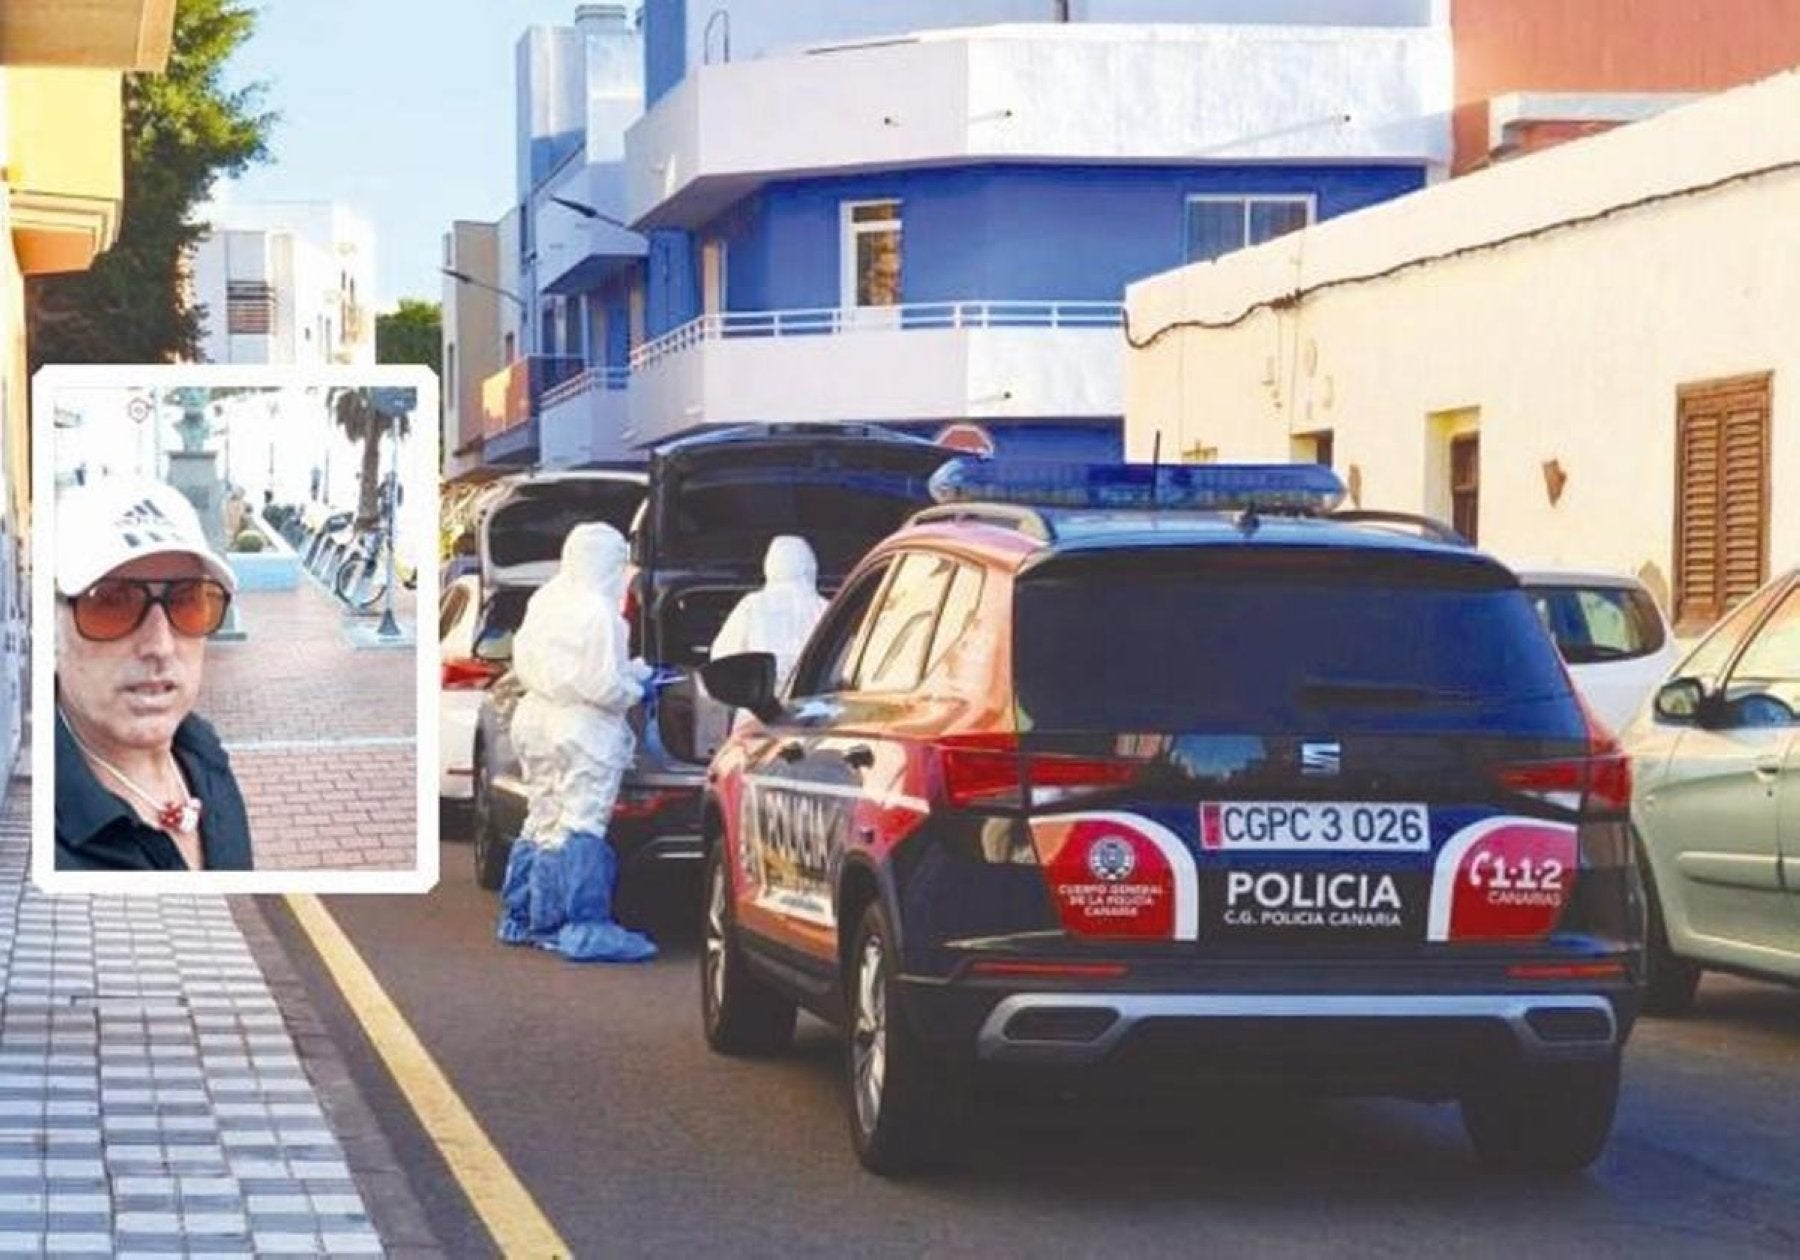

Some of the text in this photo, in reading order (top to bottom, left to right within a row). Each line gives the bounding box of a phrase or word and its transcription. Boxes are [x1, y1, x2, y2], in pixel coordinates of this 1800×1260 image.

[1223, 806, 1422, 843] CGPC 3 026
[1226, 871, 1402, 909] POLICIA
[1224, 910, 1402, 927] C.G. POLICIA CANARIA
